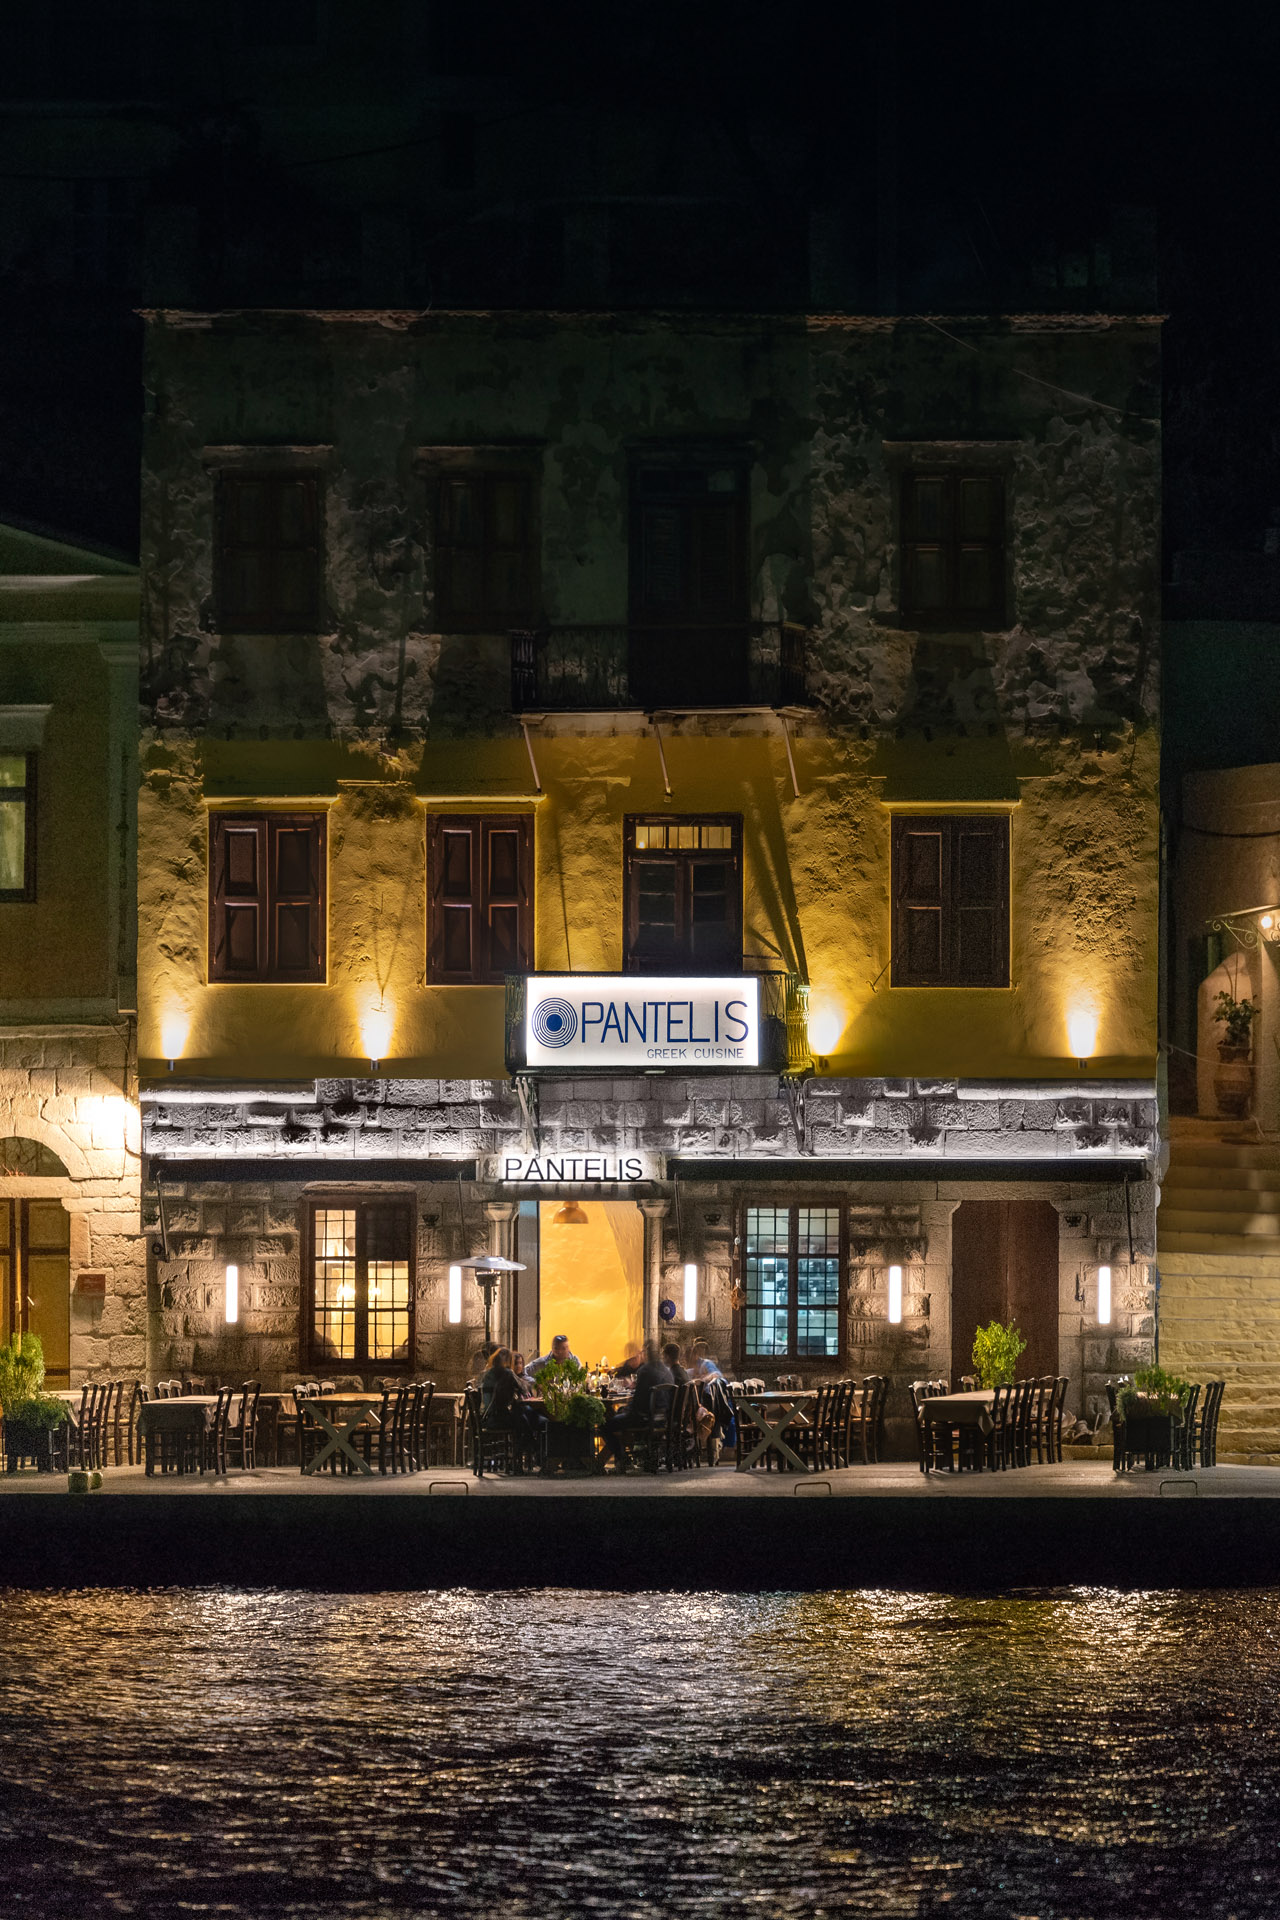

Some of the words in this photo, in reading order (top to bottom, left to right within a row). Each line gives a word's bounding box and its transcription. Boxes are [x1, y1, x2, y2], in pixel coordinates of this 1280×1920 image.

[581, 1000, 749, 1043] PANTELIS
[646, 1048, 687, 1059] GREEK
[694, 1048, 744, 1059] CUISINE
[505, 1158, 643, 1181] PANTELIS
